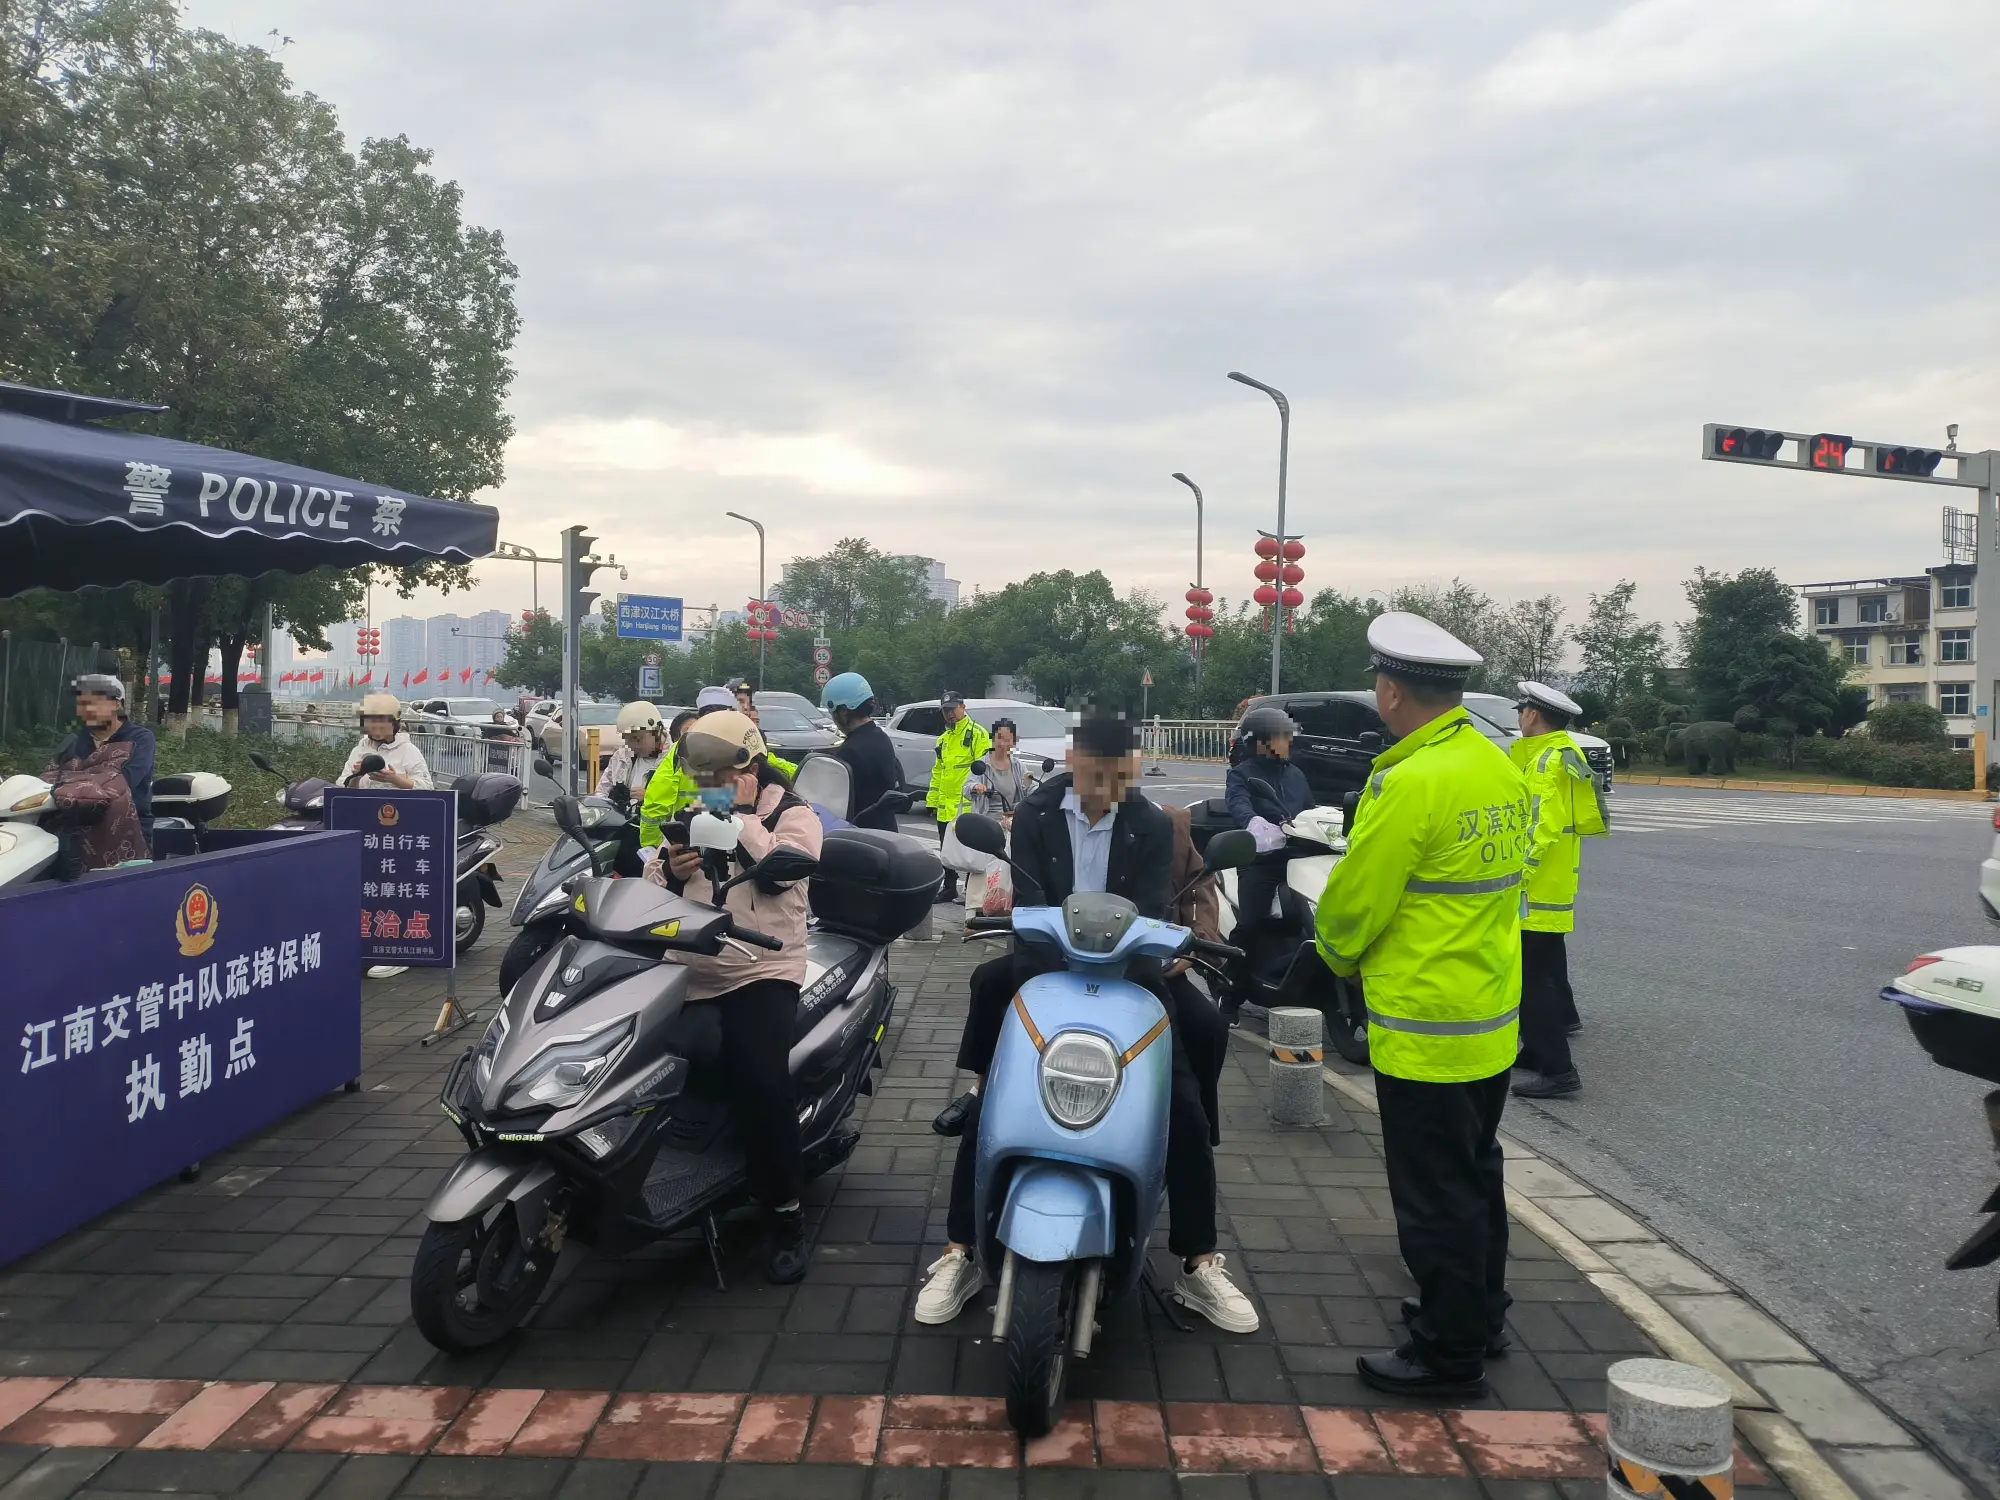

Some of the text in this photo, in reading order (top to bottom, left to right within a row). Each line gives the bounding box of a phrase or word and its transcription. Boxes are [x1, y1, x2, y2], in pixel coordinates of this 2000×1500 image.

[1814, 437, 1843, 468] 24
[123, 461, 407, 537] 警 POLICE 察
[620, 605, 680, 621] 西津汉江大桥
[636, 622, 659, 632] Hanjiang
[661, 623, 679, 632] Bridge
[20, 932, 321, 1075] 江南交管中队疏堵保畅
[125, 1017, 257, 1123] 执勤点
[634, 1062, 676, 1097] Haojue
